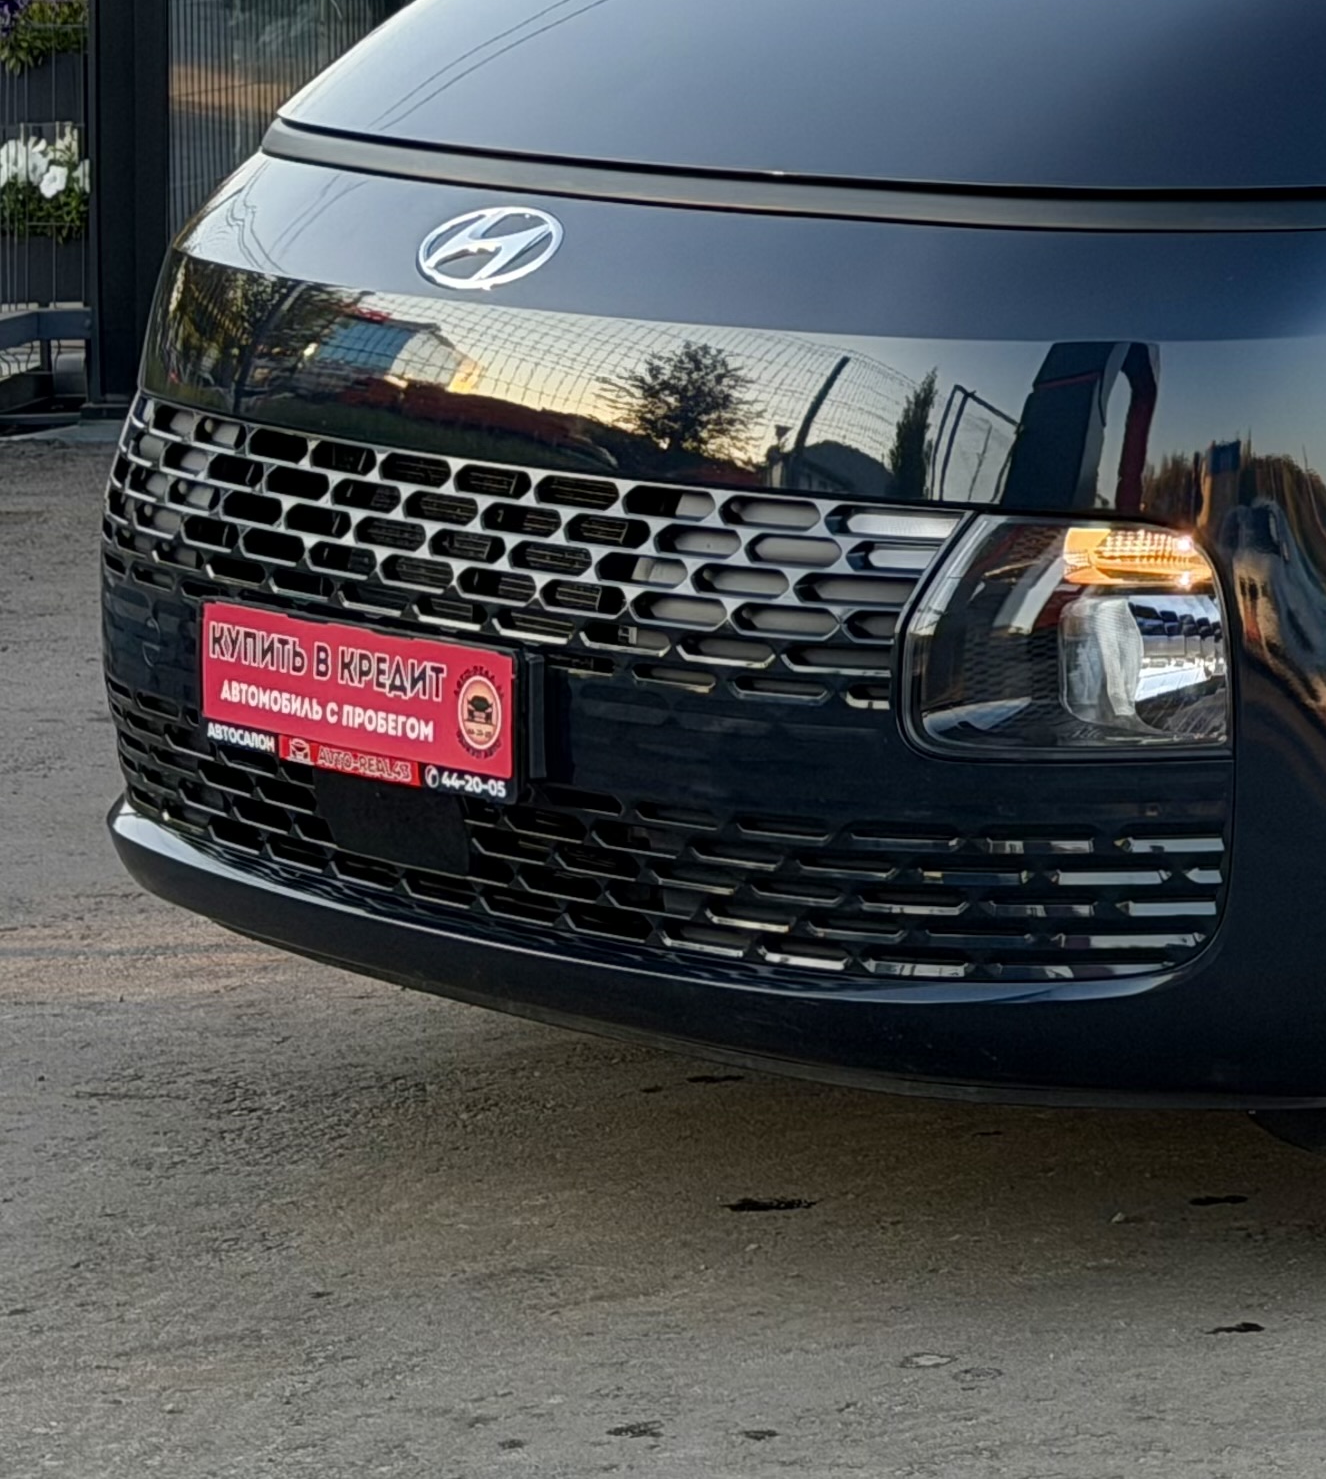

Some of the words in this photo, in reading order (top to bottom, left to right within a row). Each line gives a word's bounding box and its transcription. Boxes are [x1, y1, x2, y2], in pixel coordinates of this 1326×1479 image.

[208, 620, 308, 677] КУПИТЬ
[313, 642, 332, 680] В
[337, 646, 447, 702] КРЕДИТ
[220, 679, 322, 721] АВТОМОБИЛЬ
[325, 704, 339, 723] С
[342, 705, 435, 743] ПРОБЕГОМ
[206, 721, 276, 753] АВТОСАЛОН
[441, 770, 507, 798] 44-20-05
